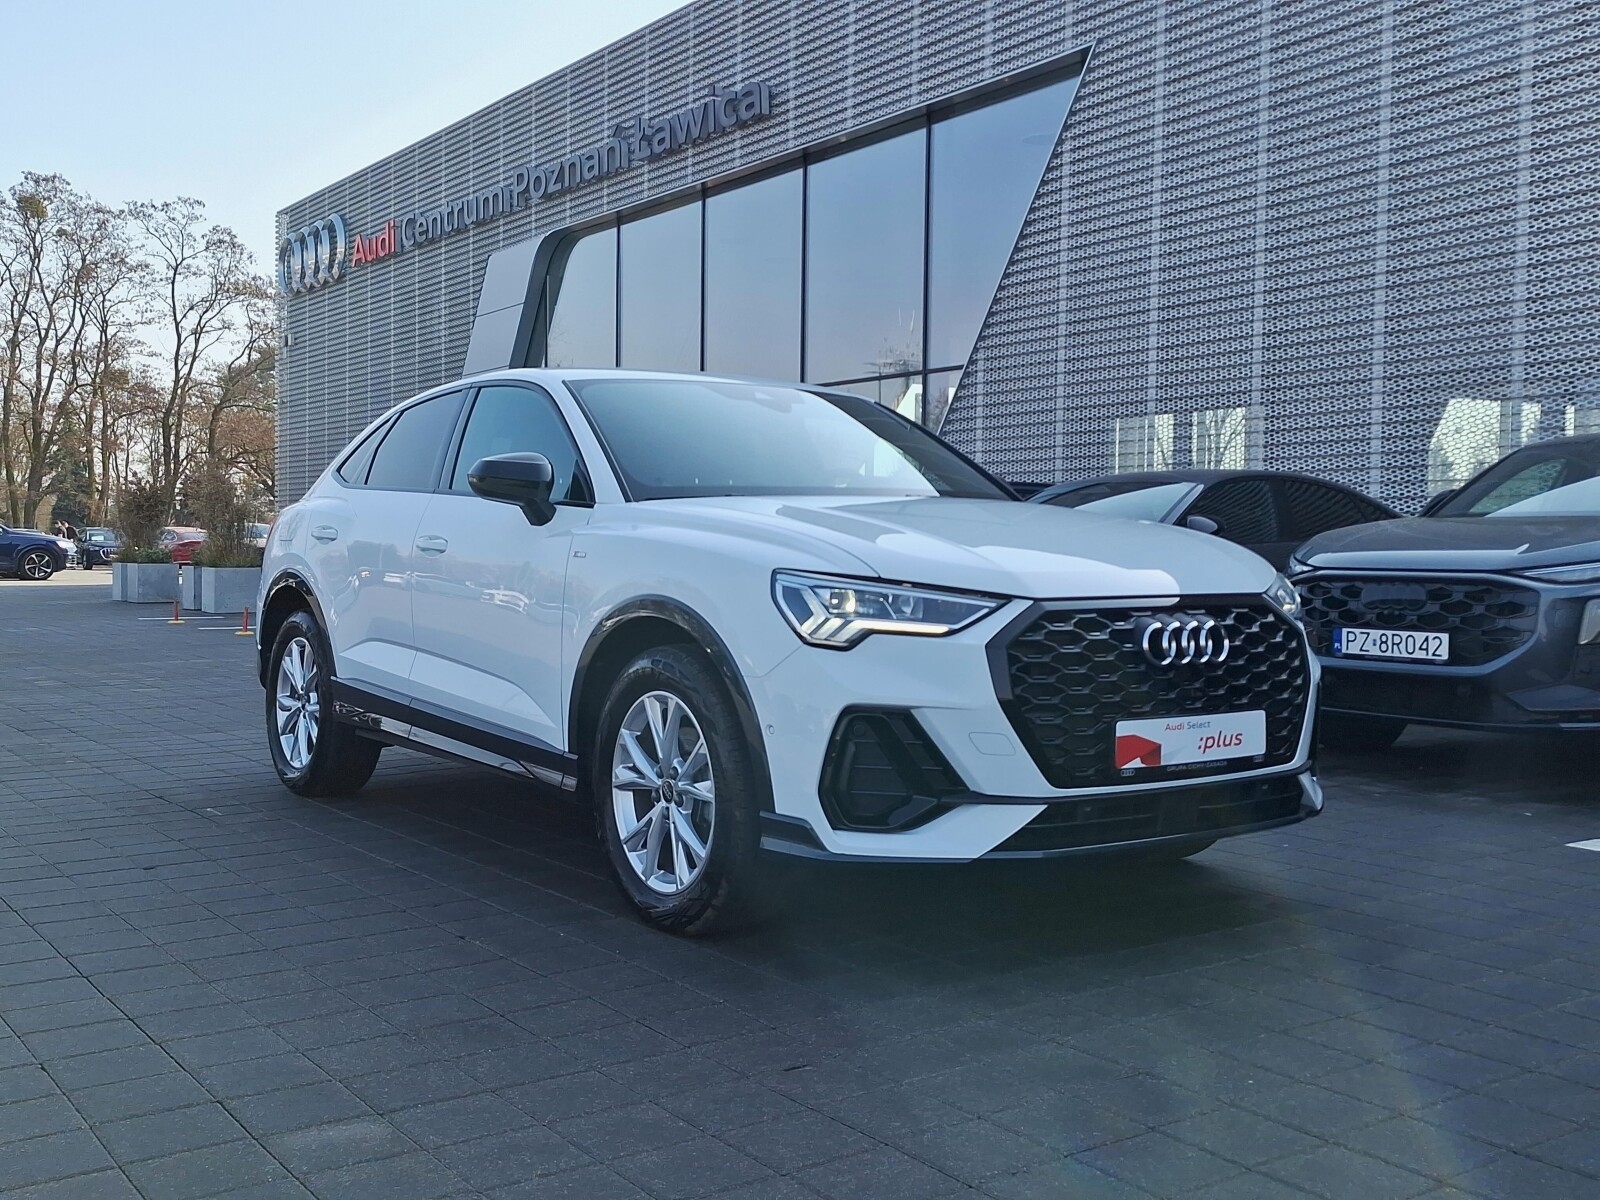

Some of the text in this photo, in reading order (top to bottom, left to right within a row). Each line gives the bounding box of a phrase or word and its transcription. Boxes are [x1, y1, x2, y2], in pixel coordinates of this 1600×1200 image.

[352, 81, 770, 267] Audi Centrum Poznań Ławica
[1346, 630, 1443, 657] PZ 8R042
[1165, 721, 1212, 731] Audi Select
[1197, 730, 1243, 754] :plus
